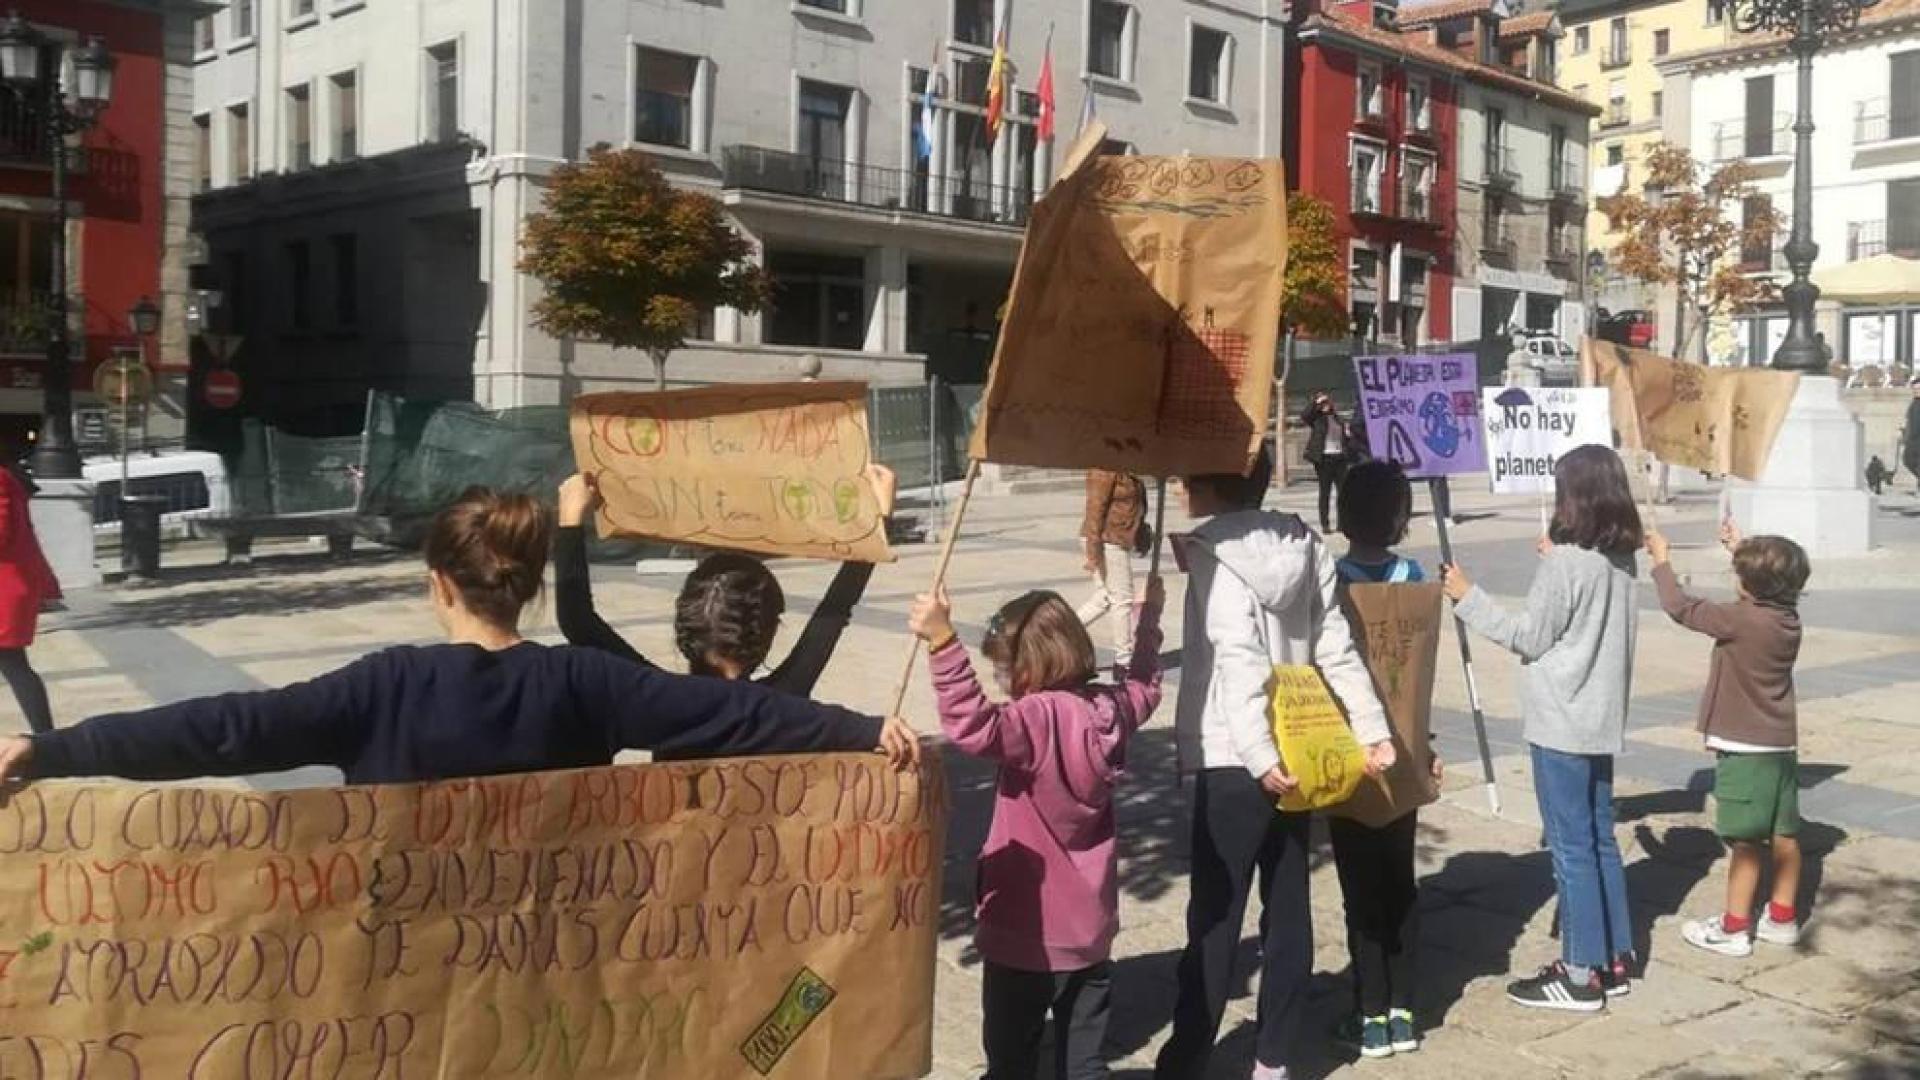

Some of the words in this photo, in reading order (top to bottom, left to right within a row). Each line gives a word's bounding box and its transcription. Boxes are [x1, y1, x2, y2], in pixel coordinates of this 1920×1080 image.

[1359, 358, 1385, 392] EL
[758, 406, 841, 460] NADA
[1504, 404, 1531, 430] No
[1537, 405, 1577, 437] hay
[49, 931, 323, 1006] ATRAPADO
[784, 882, 866, 946] QUE
